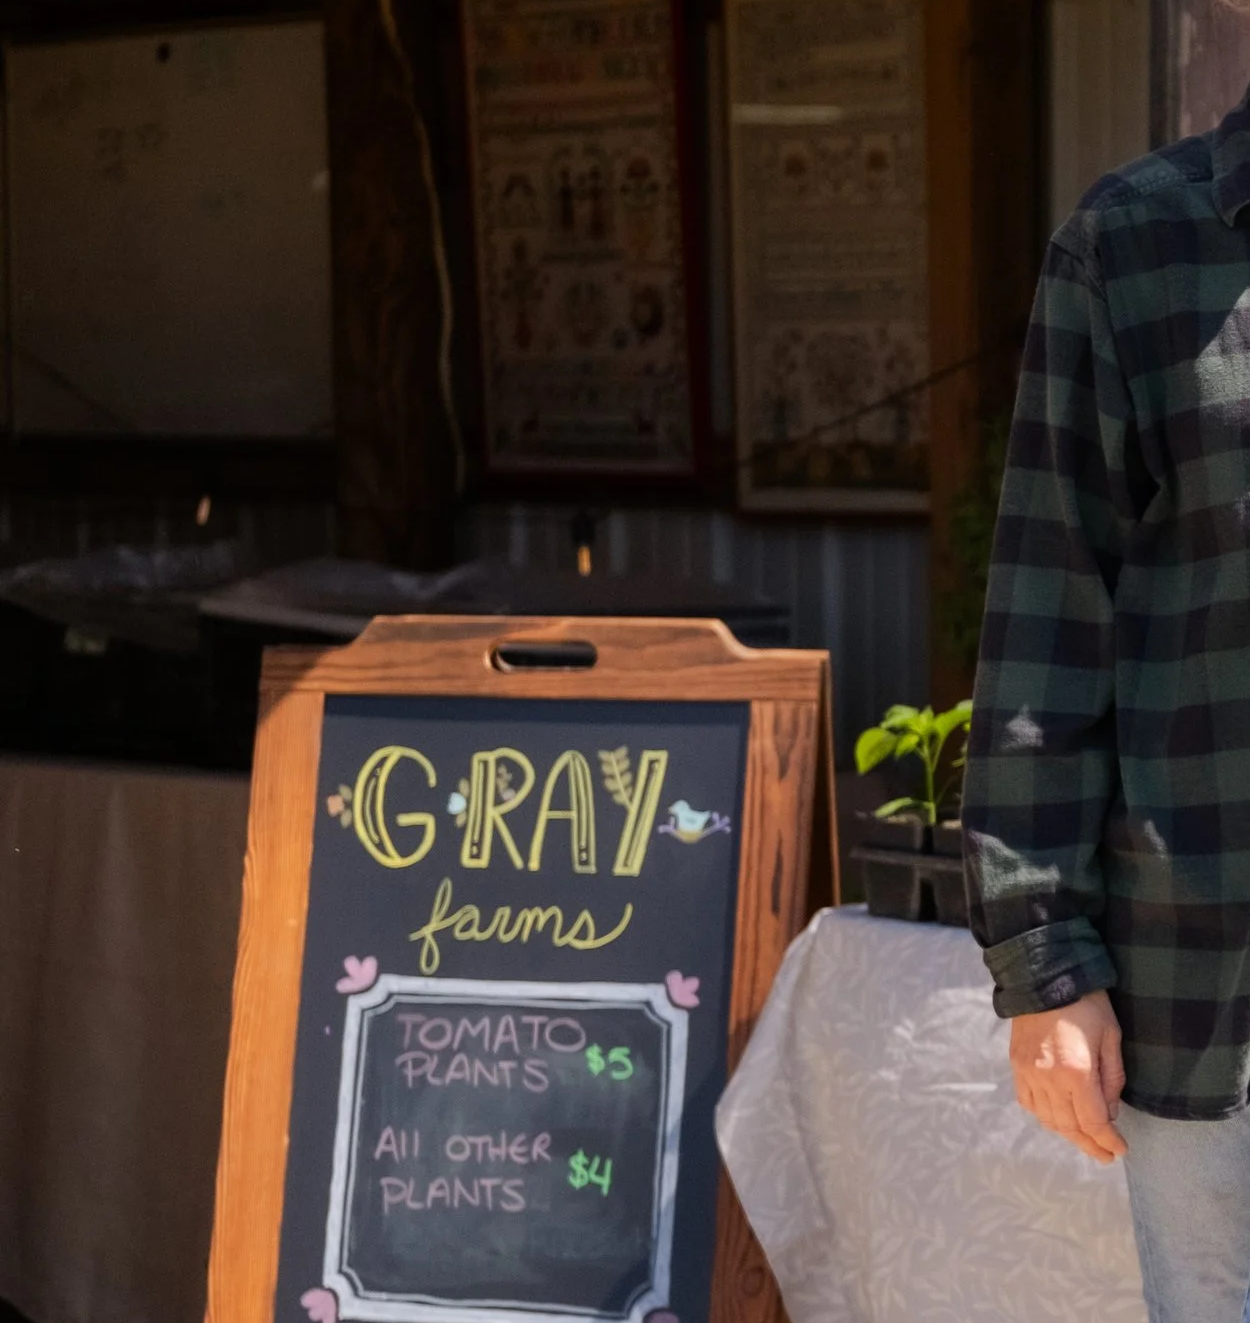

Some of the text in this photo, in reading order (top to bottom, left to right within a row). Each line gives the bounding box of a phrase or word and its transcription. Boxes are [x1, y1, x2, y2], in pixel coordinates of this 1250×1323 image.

[353, 745, 668, 877] GRAY
[409, 877, 634, 975] farms
[396, 1013, 587, 1054] TOMATO
[394, 1043, 634, 1093] PLANTS $5
[374, 1125, 552, 1165] All OTHER
[380, 1176, 527, 1217] PLANTS
[567, 1147, 612, 1197] $4
